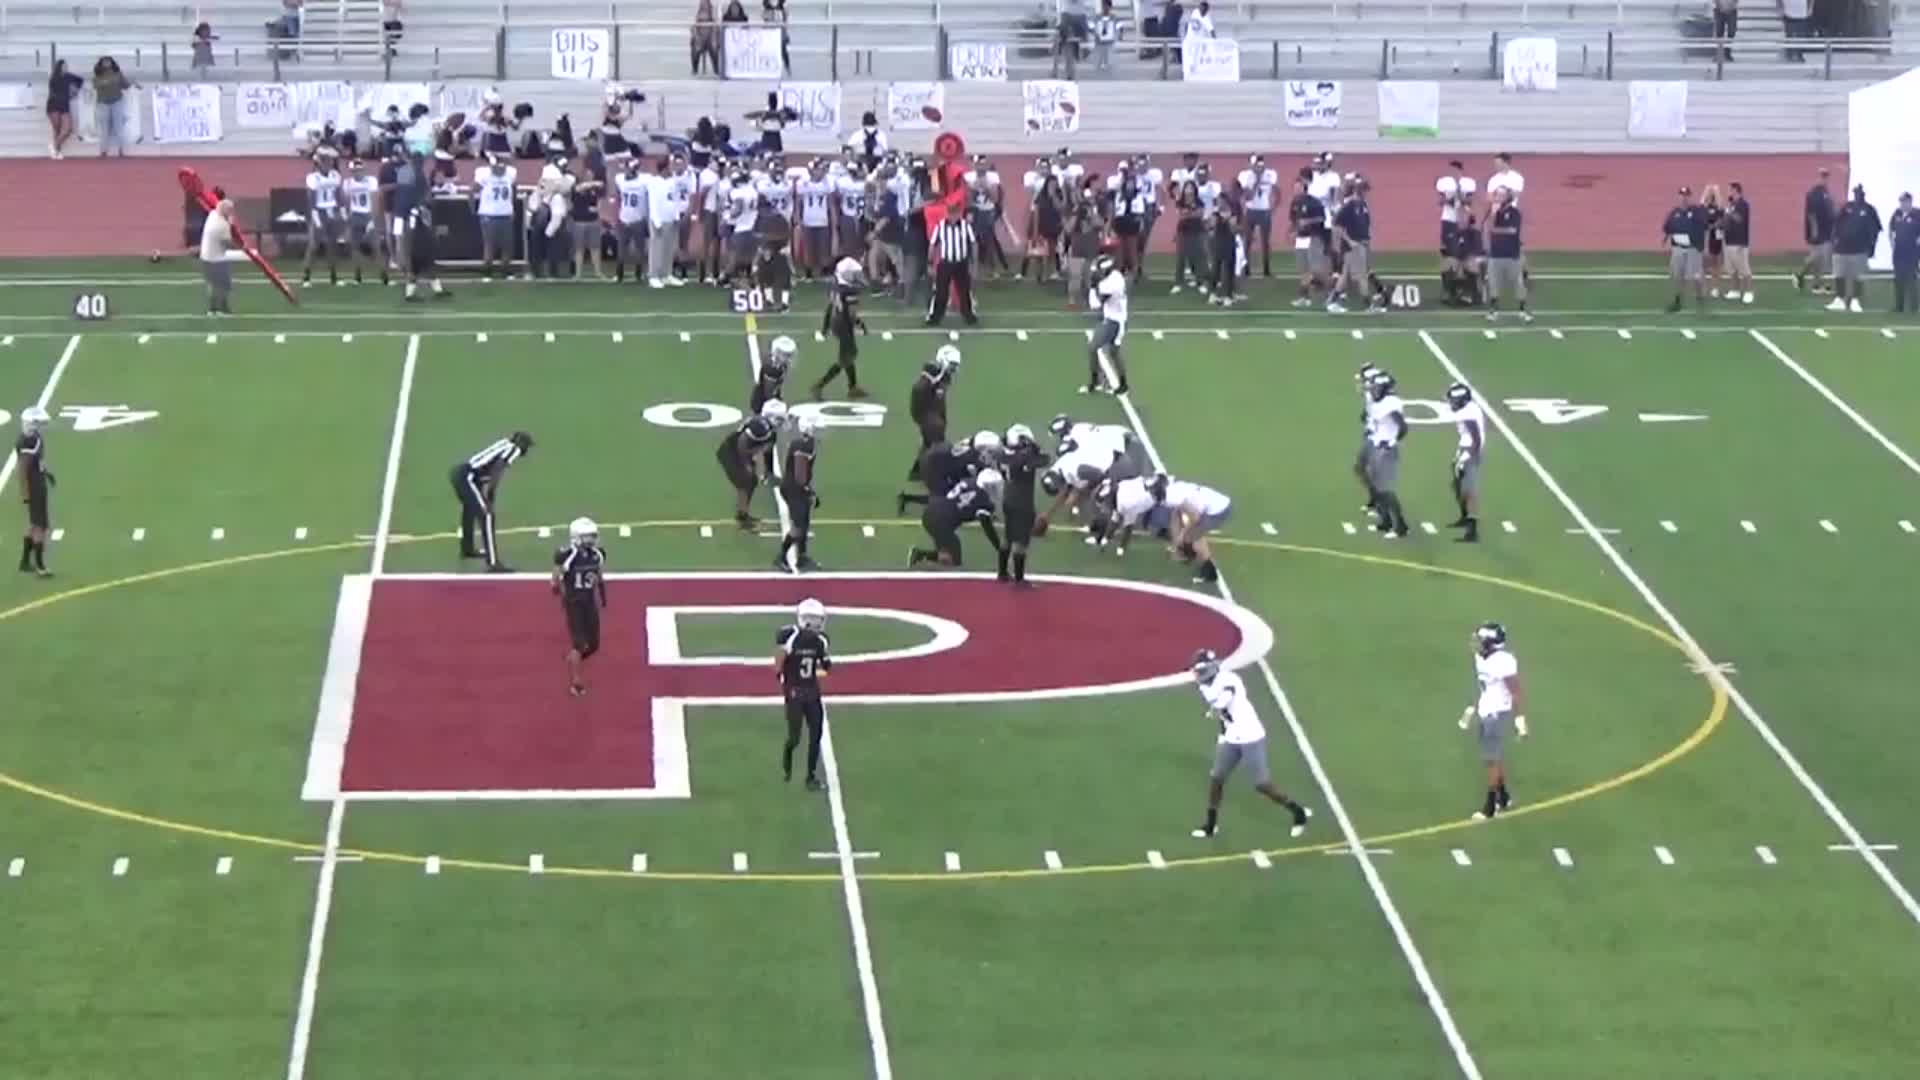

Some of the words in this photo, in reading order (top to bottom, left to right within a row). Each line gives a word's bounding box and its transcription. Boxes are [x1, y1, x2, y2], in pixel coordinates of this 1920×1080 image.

[75, 294, 107, 318] 40
[733, 290, 764, 312] 50
[1391, 284, 1421, 307] 40
[799, 657, 814, 679] 3
